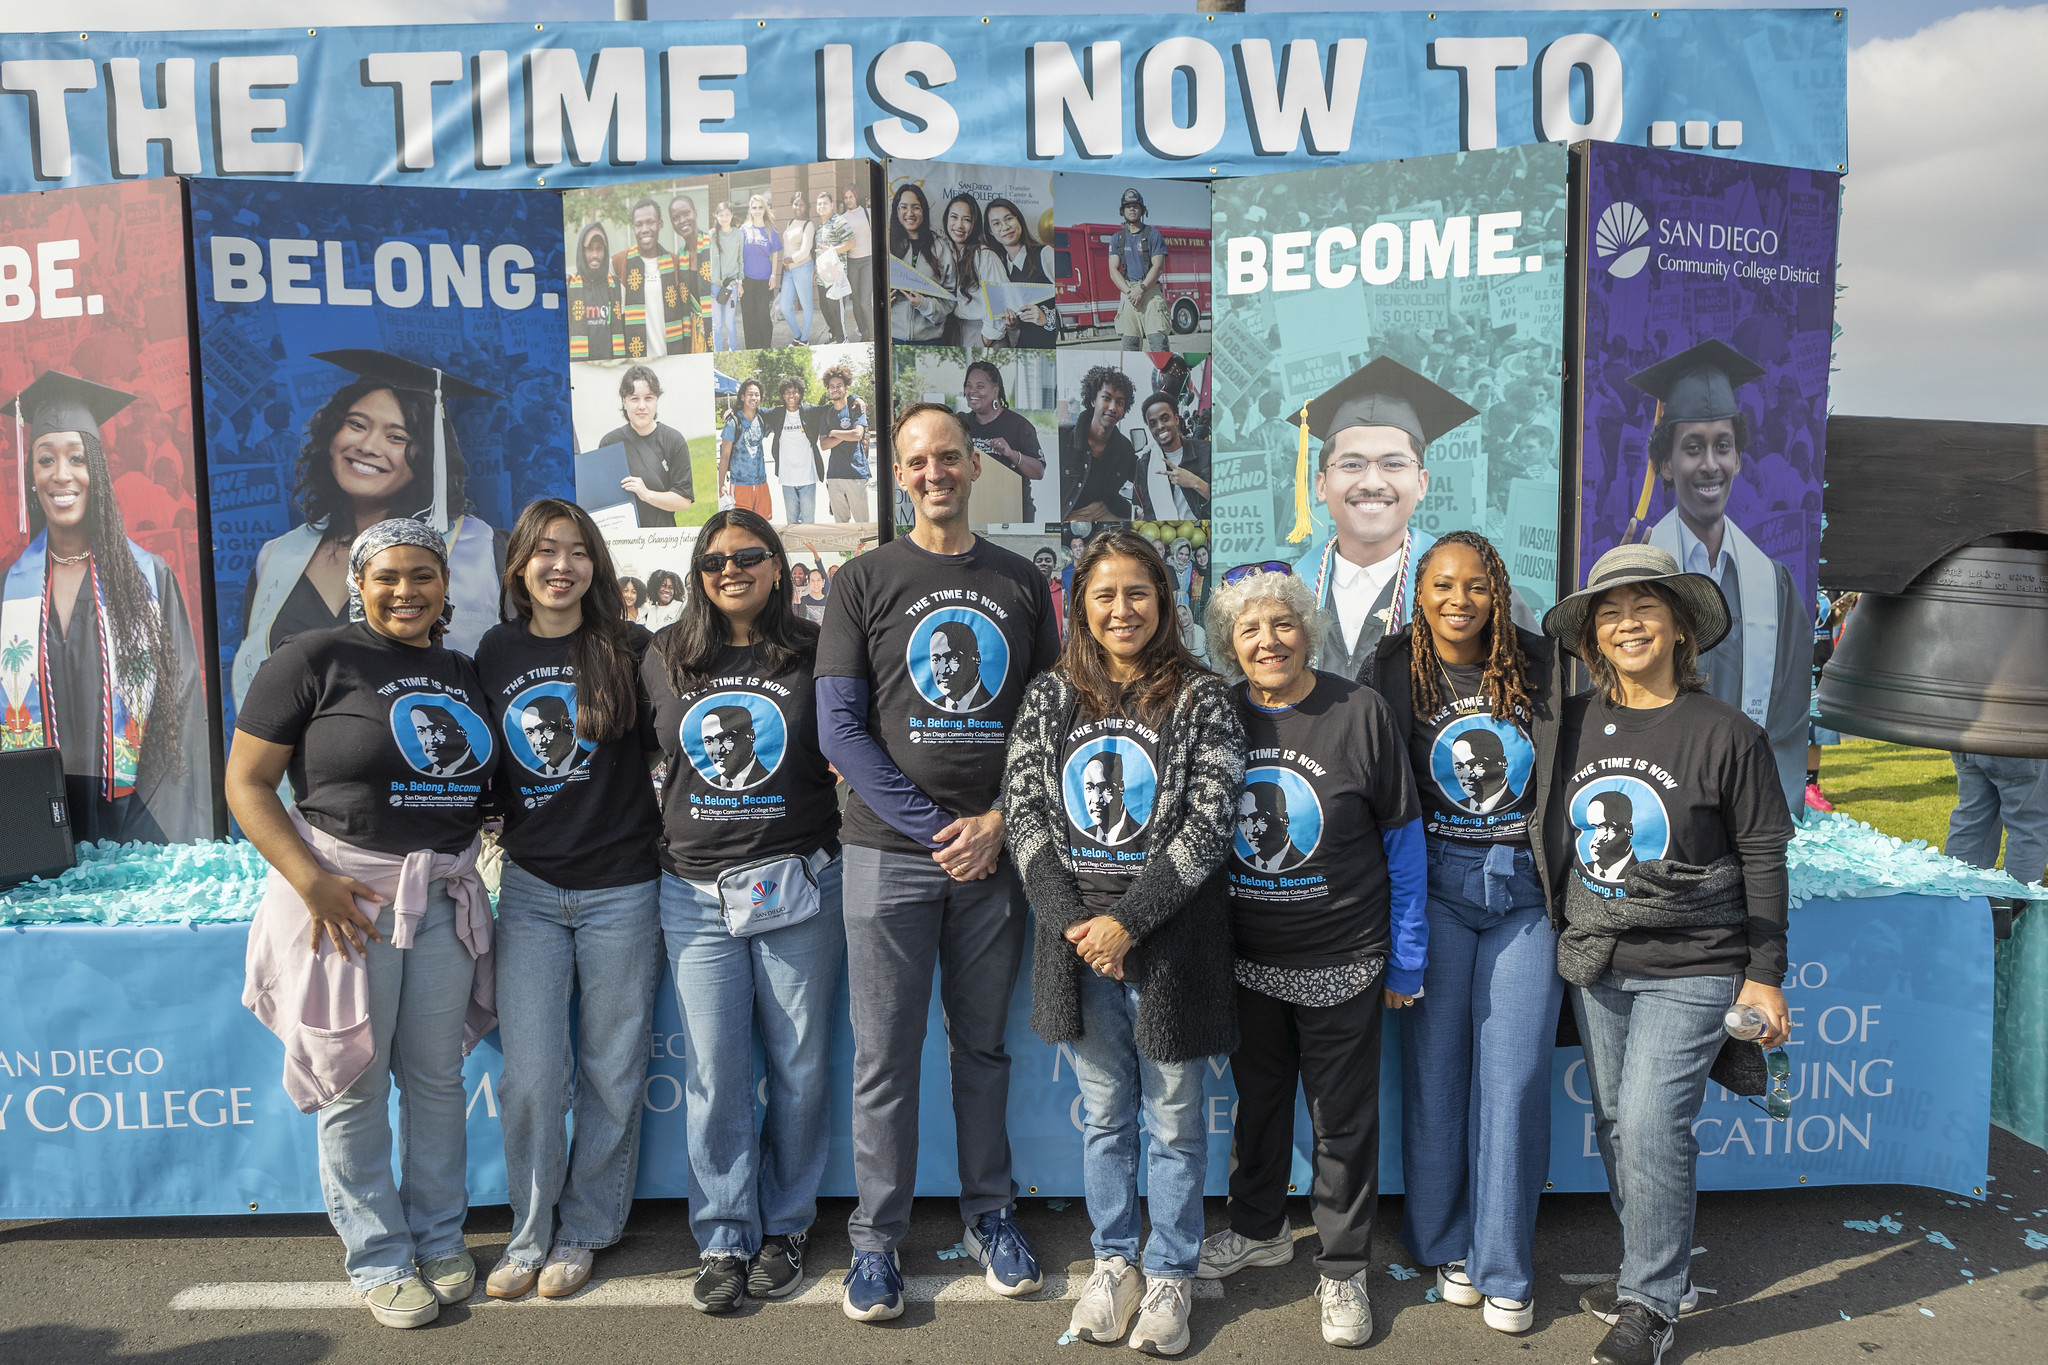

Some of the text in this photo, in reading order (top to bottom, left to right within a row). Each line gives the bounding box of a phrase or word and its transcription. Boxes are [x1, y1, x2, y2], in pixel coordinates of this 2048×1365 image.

[2, 55, 304, 181] THE
[360, 44, 749, 172] TIME
[815, 41, 960, 161] IS
[1025, 36, 1368, 161] NOW
[958, 181, 993, 191] SAN DIEGO
[1189, 237, 1205, 247] FIRE
[1658, 218, 1779, 255] SAN DIEGO
[1227, 211, 1543, 295] BECOME.
[211, 236, 560, 309] BELONG.
[1657, 253, 1821, 285] Community College District
[0, 239, 104, 323] BE.
[1374, 293, 1447, 307] BENEVOLENT
[1382, 309, 1444, 323] SOCIETY
[396, 330, 458, 346] SOCIETY
[1216, 332, 1247, 364] JOBS
[207, 337, 247, 371] JOBS
[1304, 357, 1324, 370] WE
[1291, 364, 1342, 387] MARCH
[1213, 458, 1242, 480] WE
[214, 471, 249, 493] WE
[905, 589, 1009, 620] THE TIME IS NOW
[377, 681, 399, 697] THE
[397, 676, 429, 687] TIME
[431, 679, 442, 690] IS
[503, 665, 575, 696] THE TIME IS
[710, 676, 792, 698] TIME IS NOW
[1450, 696, 1485, 711] TIME
[909, 717, 1004, 731] Be. Belong. Become.
[1067, 723, 1093, 743] THE
[1095, 717, 1123, 729] TIME
[1134, 723, 1160, 745] NOW
[1249, 748, 1327, 777] TIME IS NOW
[1572, 757, 1678, 790] THE TIME IS NOW
[391, 781, 408, 792] Be.
[410, 781, 446, 794] Belong.
[520, 785, 536, 796] Be.
[415, 795, 429, 803] Diego
[429, 795, 453, 803] Community
[690, 793, 785, 808] Be. Belong. Become.
[750, 806, 769, 814] College
[1434, 811, 1449, 823] Be.
[1449, 815, 1485, 828] Belong.
[1440, 823, 1449, 831] San
[1449, 825, 1465, 833] Diego
[1491, 823, 1510, 832] College
[1078, 860, 1088, 868] San
[1081, 846, 1115, 861] Belong.
[1240, 874, 1326, 889] Belong. Become.
[1246, 887, 1261, 896] Diego
[1261, 888, 1290, 897] Community
[1310, 884, 1329, 893] District
[755, 906, 786, 918] SAN DIEGO
[1818, 1004, 1882, 1045] OF
[51, 1047, 164, 1076] DIEGO
[25, 1085, 254, 1132] COLLEGE
